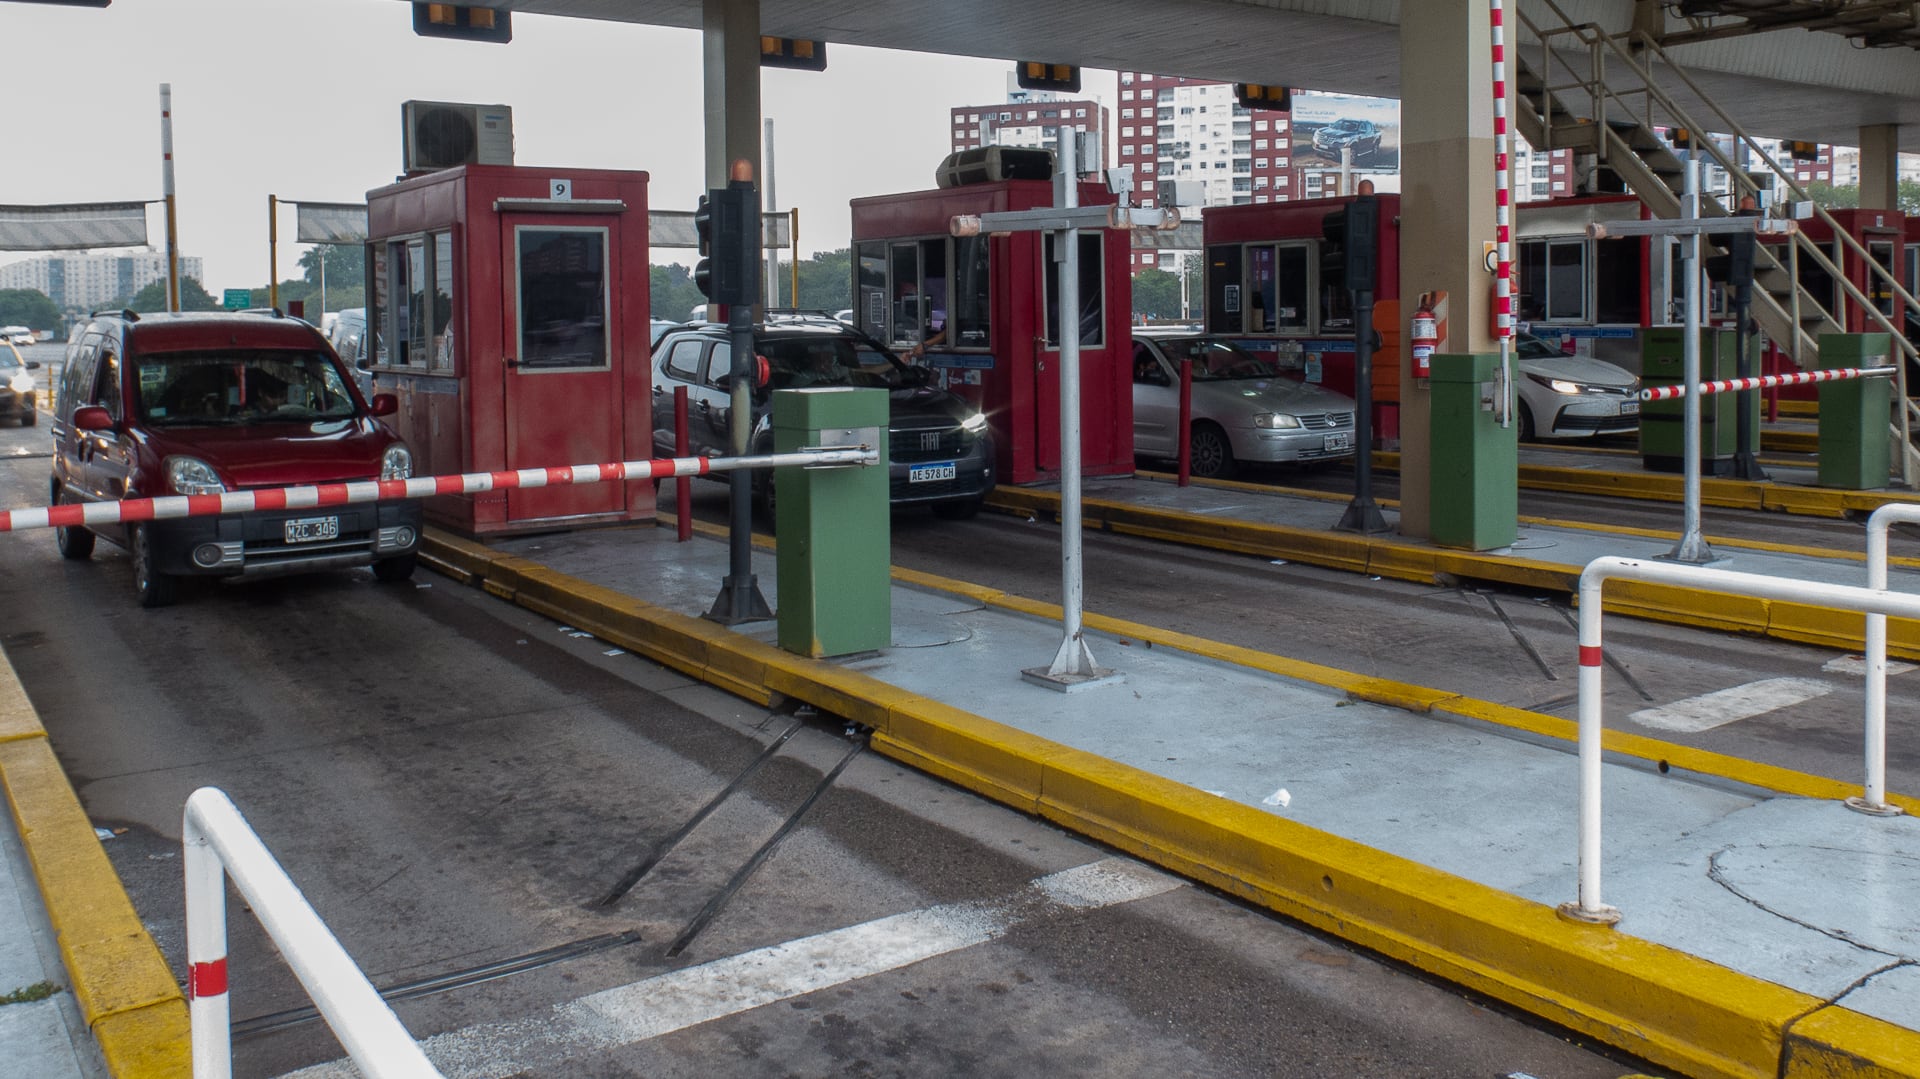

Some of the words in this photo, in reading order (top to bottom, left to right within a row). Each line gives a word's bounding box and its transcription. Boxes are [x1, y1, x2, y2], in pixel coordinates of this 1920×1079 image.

[555, 183, 565, 196] 9
[920, 431, 940, 451] FIAT
[912, 470, 923, 481] AE
[925, 469, 941, 480] 578
[943, 467, 954, 478] CH
[288, 525, 309, 538] MZC
[315, 522, 336, 536] 346
